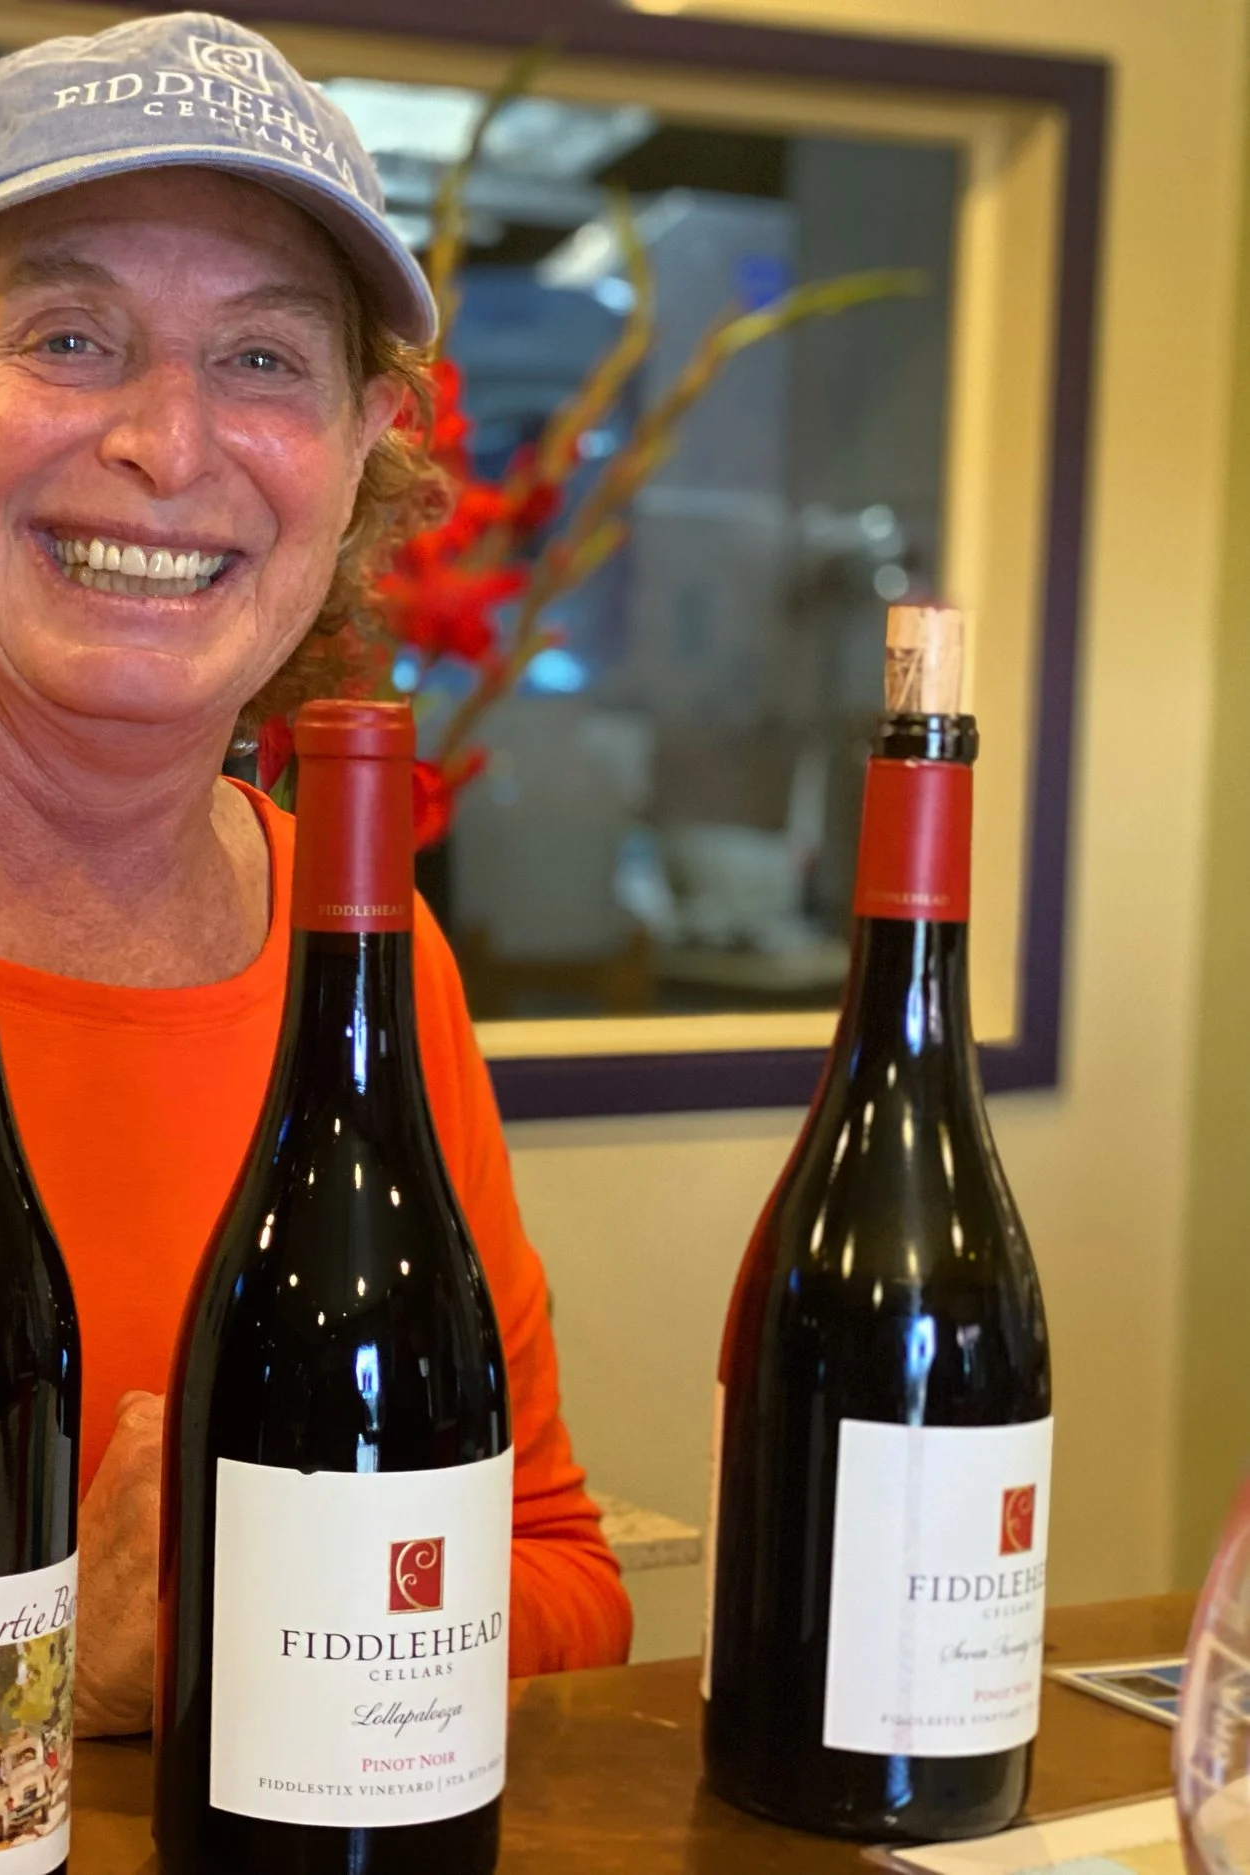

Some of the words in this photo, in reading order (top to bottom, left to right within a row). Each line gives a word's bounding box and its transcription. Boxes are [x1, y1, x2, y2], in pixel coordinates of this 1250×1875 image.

[143, 100, 314, 167] CELLARS
[317, 904, 406, 917] FIDDLEHEAD
[280, 1611, 503, 1662] FIDDLEHEAD
[369, 1662, 454, 1682] CELLARS
[351, 1697, 463, 1739] Lollapalooza
[361, 1757, 416, 1773] PINOT
[420, 1751, 456, 1769] NOIR
[258, 1776, 353, 1796] FIDDLESTIX
[359, 1778, 434, 1796] VINEYARD
